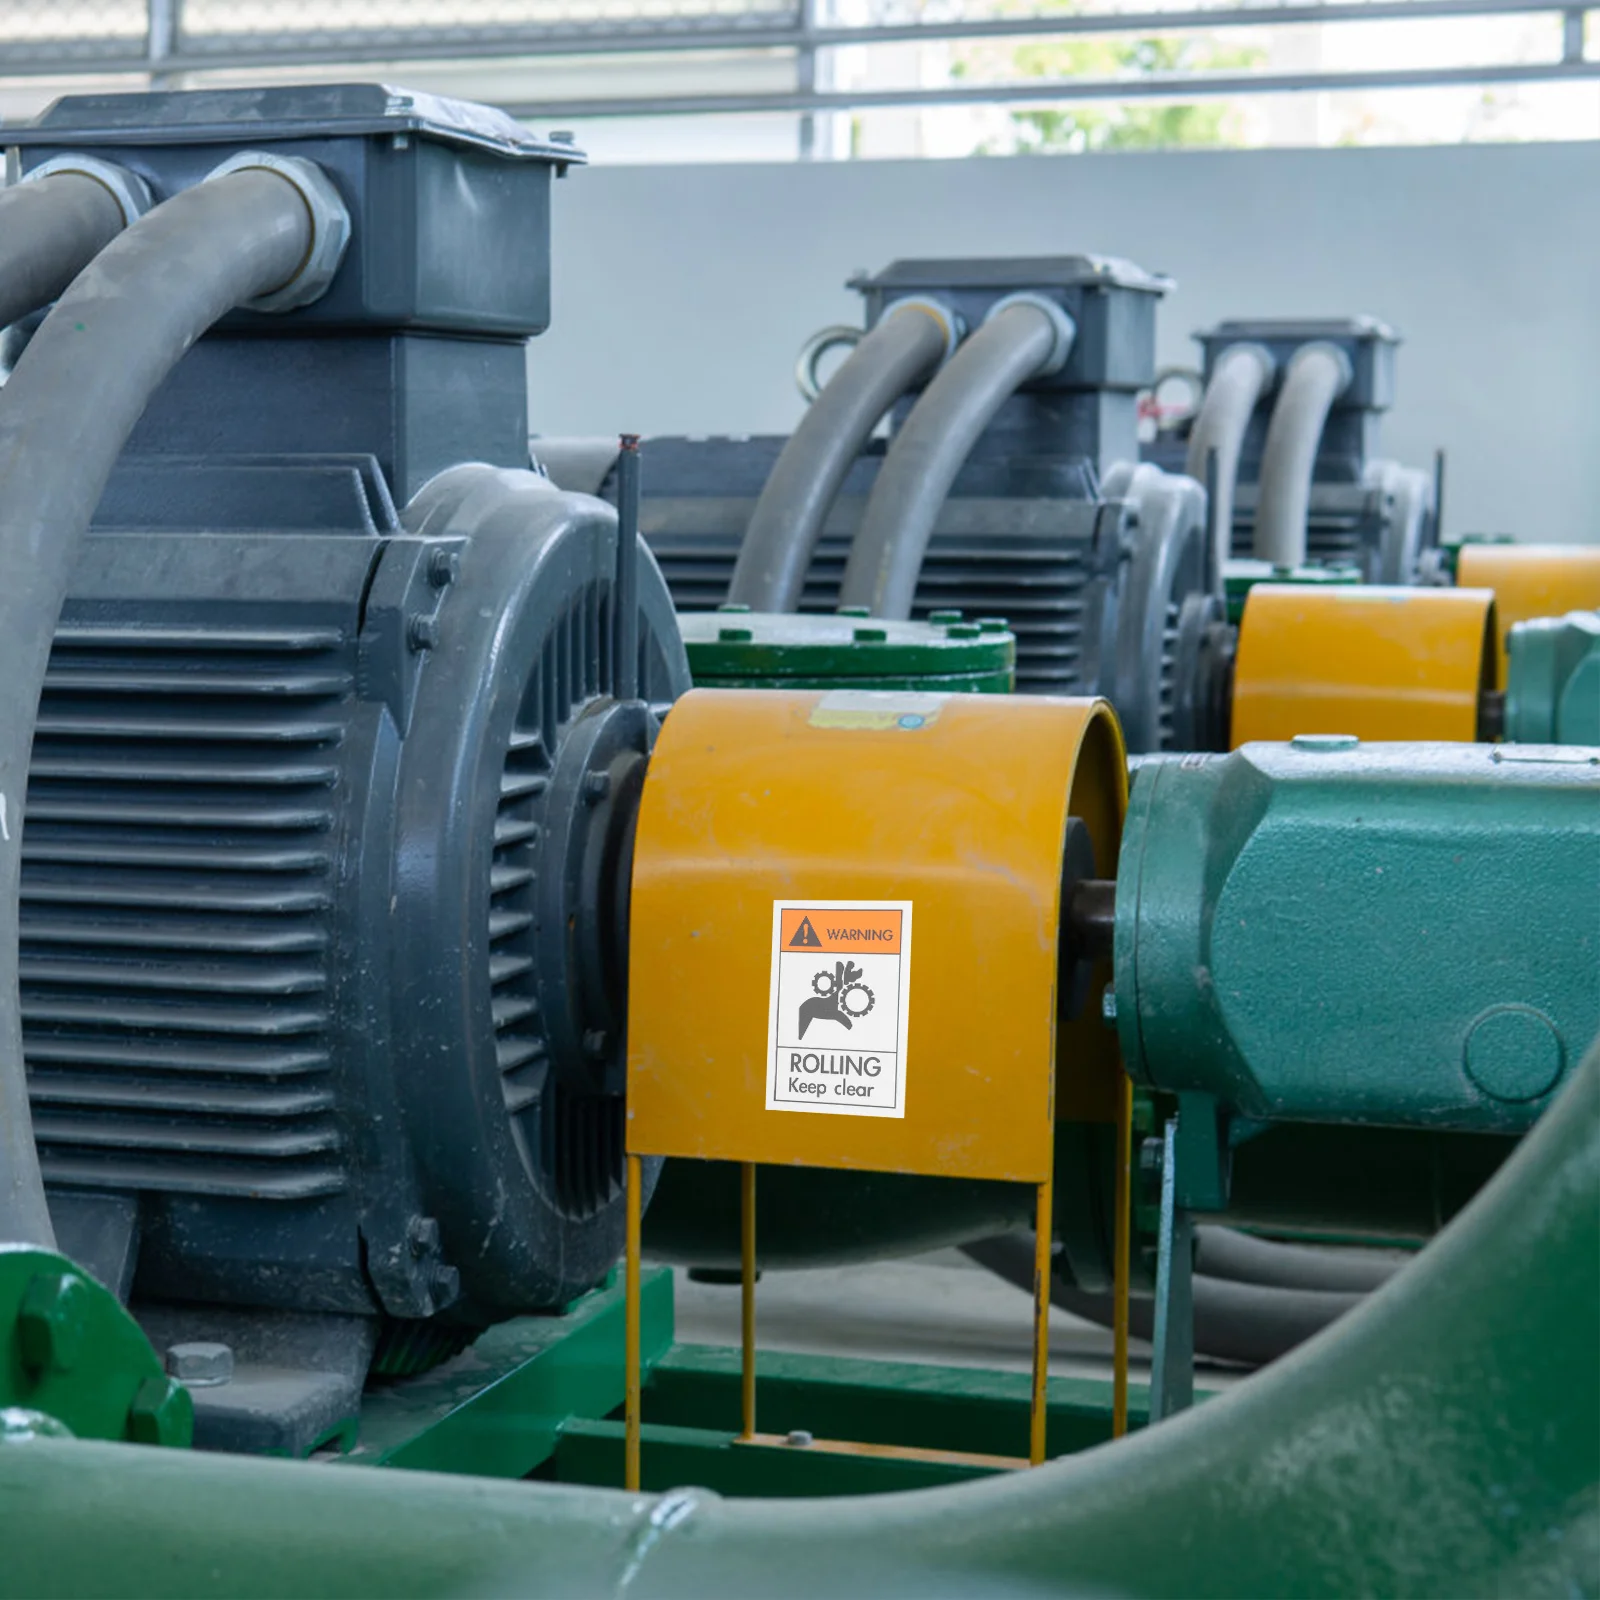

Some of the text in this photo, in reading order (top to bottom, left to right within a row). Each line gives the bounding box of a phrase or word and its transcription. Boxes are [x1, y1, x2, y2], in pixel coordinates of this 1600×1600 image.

[827, 928, 894, 941] WARNING
[790, 1053, 882, 1077] ROLLING
[788, 1077, 875, 1098] Keep clear
